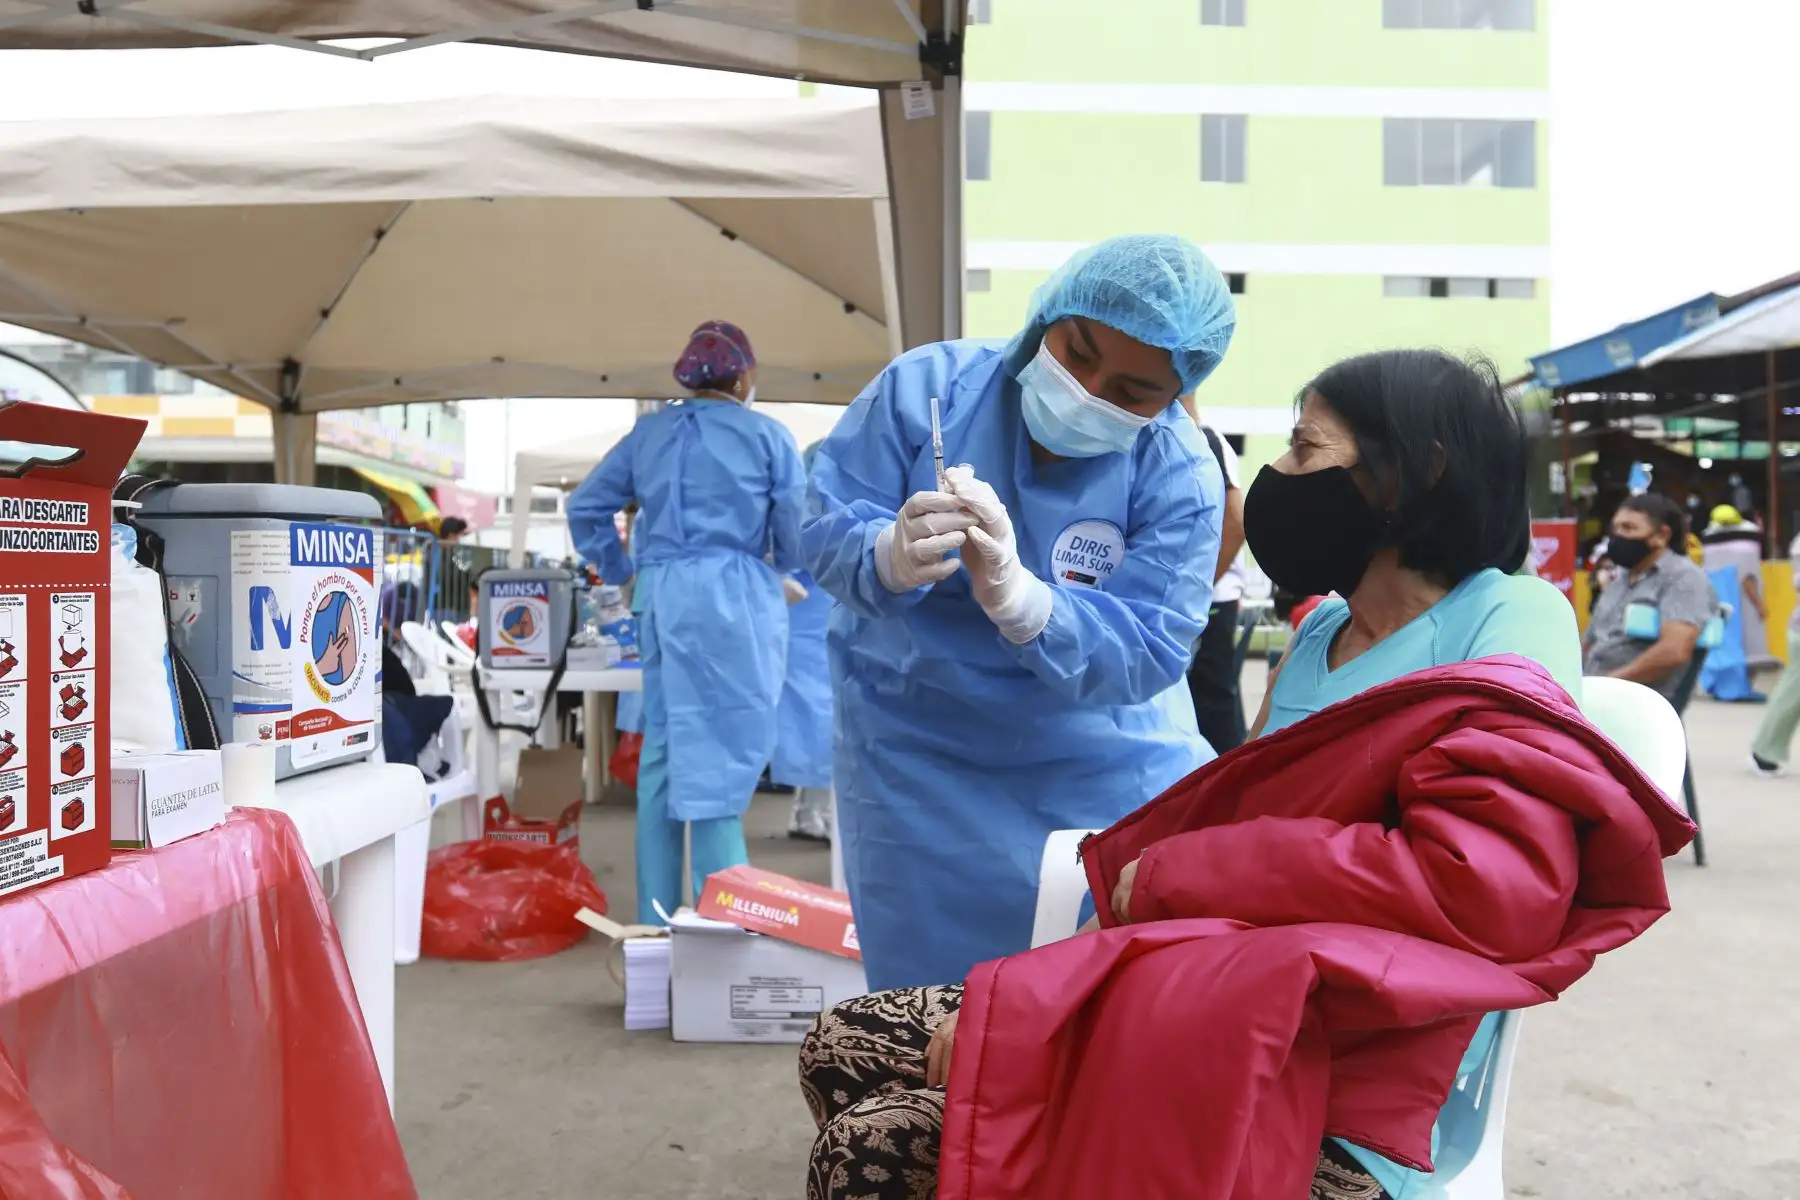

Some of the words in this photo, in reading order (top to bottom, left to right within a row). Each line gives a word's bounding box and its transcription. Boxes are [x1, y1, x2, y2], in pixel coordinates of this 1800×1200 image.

[24, 500, 87, 523] DESCARTE
[296, 528, 370, 565] MINSA
[1070, 535, 1112, 559] DIRIS
[1055, 549, 1085, 567] LIMA
[1087, 558, 1114, 575] SUR
[493, 582, 546, 596] MINSA
[300, 601, 313, 643] Pongo
[312, 585, 319, 601] el
[317, 572, 346, 591] hombro
[345, 580, 359, 595] por
[151, 792, 186, 811] GUANTES
[187, 788, 198, 800] DE
[198, 781, 220, 797] LATEX
[151, 808, 165, 819] PARA
[166, 801, 188, 814] EXAMEN
[716, 890, 800, 927] MILLENIUM
